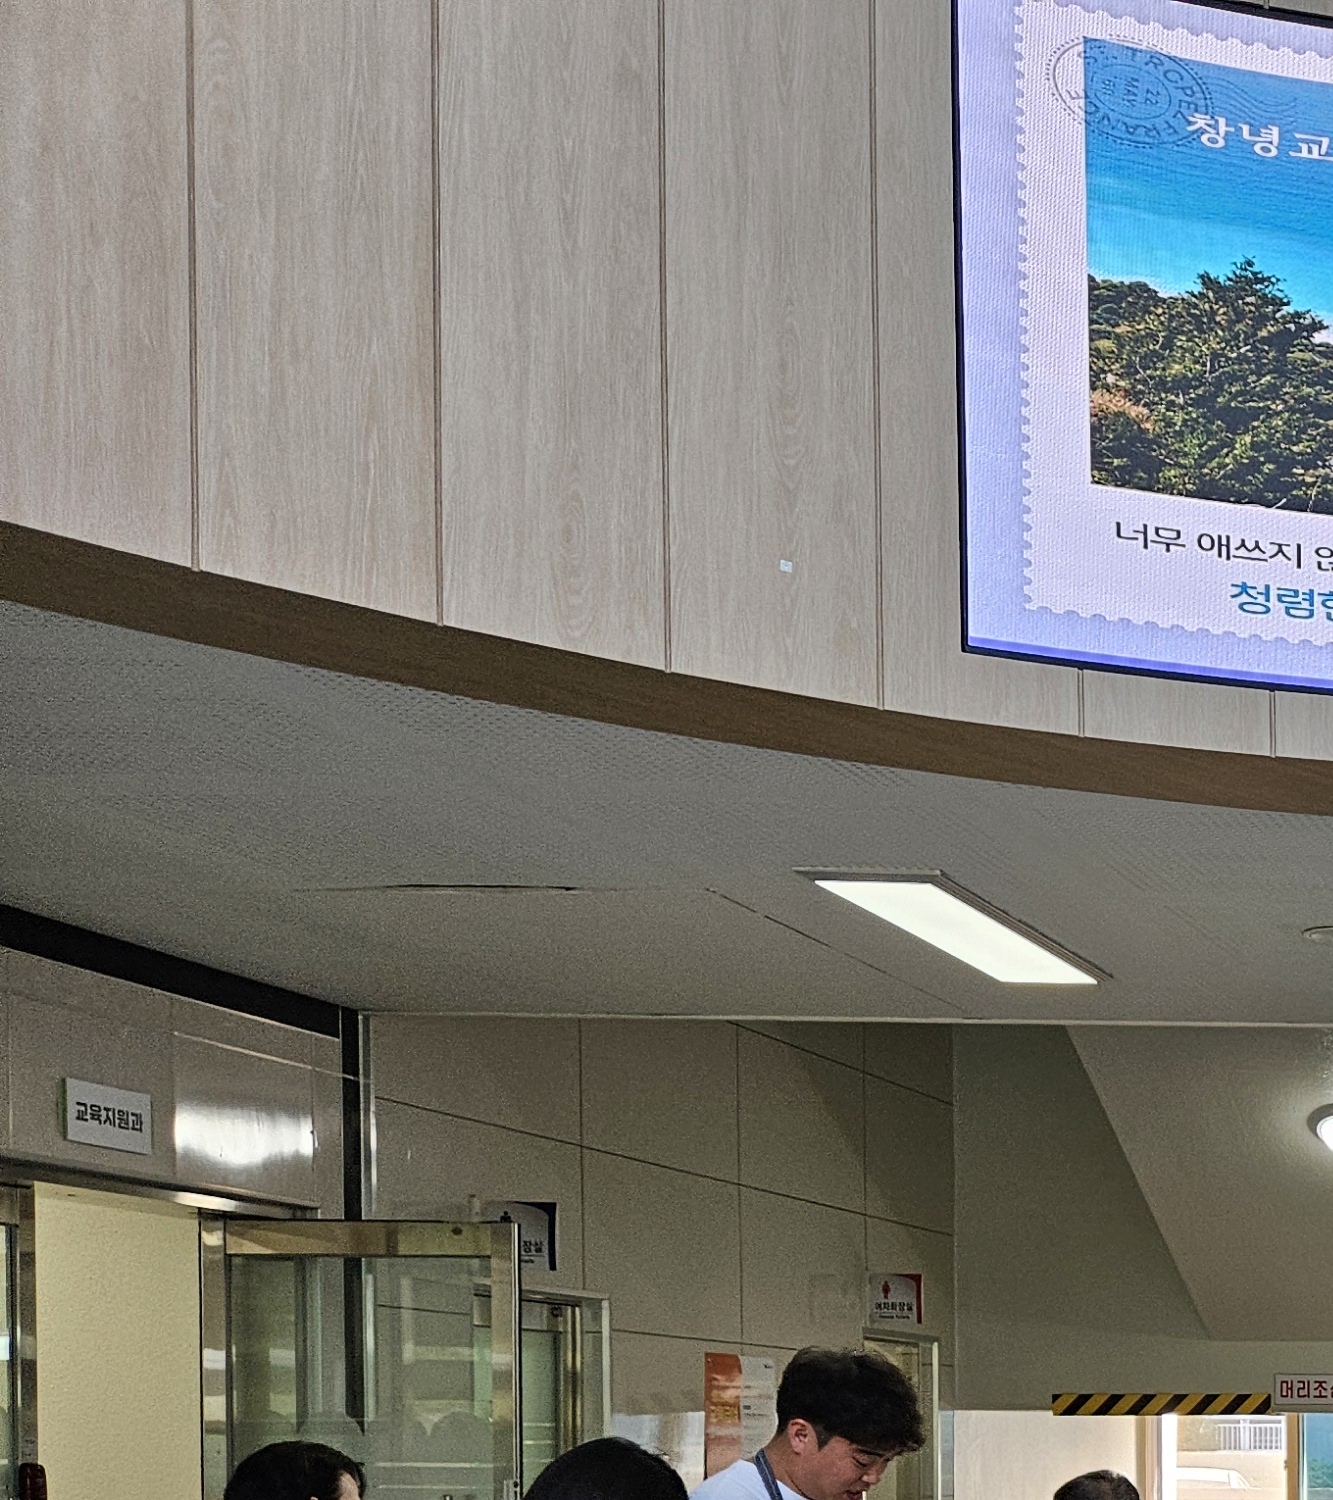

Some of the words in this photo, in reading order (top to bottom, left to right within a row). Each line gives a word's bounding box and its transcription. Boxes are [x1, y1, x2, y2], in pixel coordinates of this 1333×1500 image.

[1114, 521, 1186, 553] 너무
[1197, 531, 1303, 570] 애쓰지
[75, 1101, 143, 1133] 교육지원과
